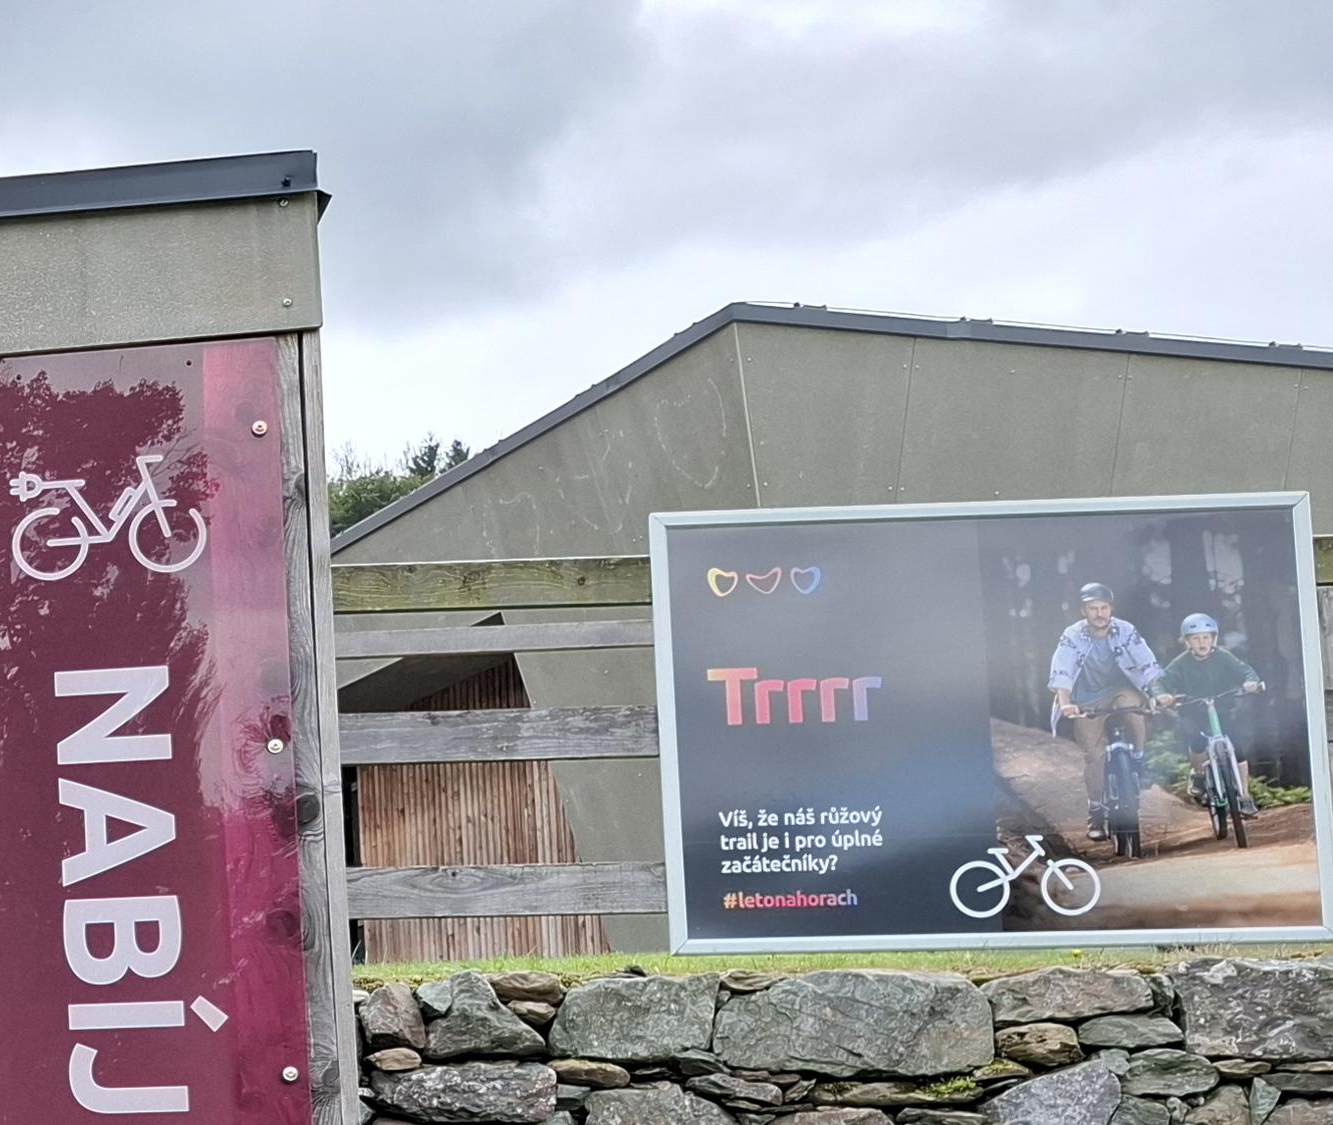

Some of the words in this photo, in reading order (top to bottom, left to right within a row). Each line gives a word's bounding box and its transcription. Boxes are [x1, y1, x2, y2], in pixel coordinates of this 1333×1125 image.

[707, 667, 882, 725] Trrrr
[718, 809, 753, 829] Víš,
[757, 809, 779, 827] že
[784, 808, 815, 826] náš
[820, 806, 882, 827] růžový
[720, 832, 759, 851] trail
[761, 832, 780, 853] je
[784, 831, 790, 849] i
[795, 834, 826, 852] pro
[831, 829, 883, 850] úplné
[721, 854, 838, 875] začátečníky?
[723, 888, 858, 909] #letonahorach
